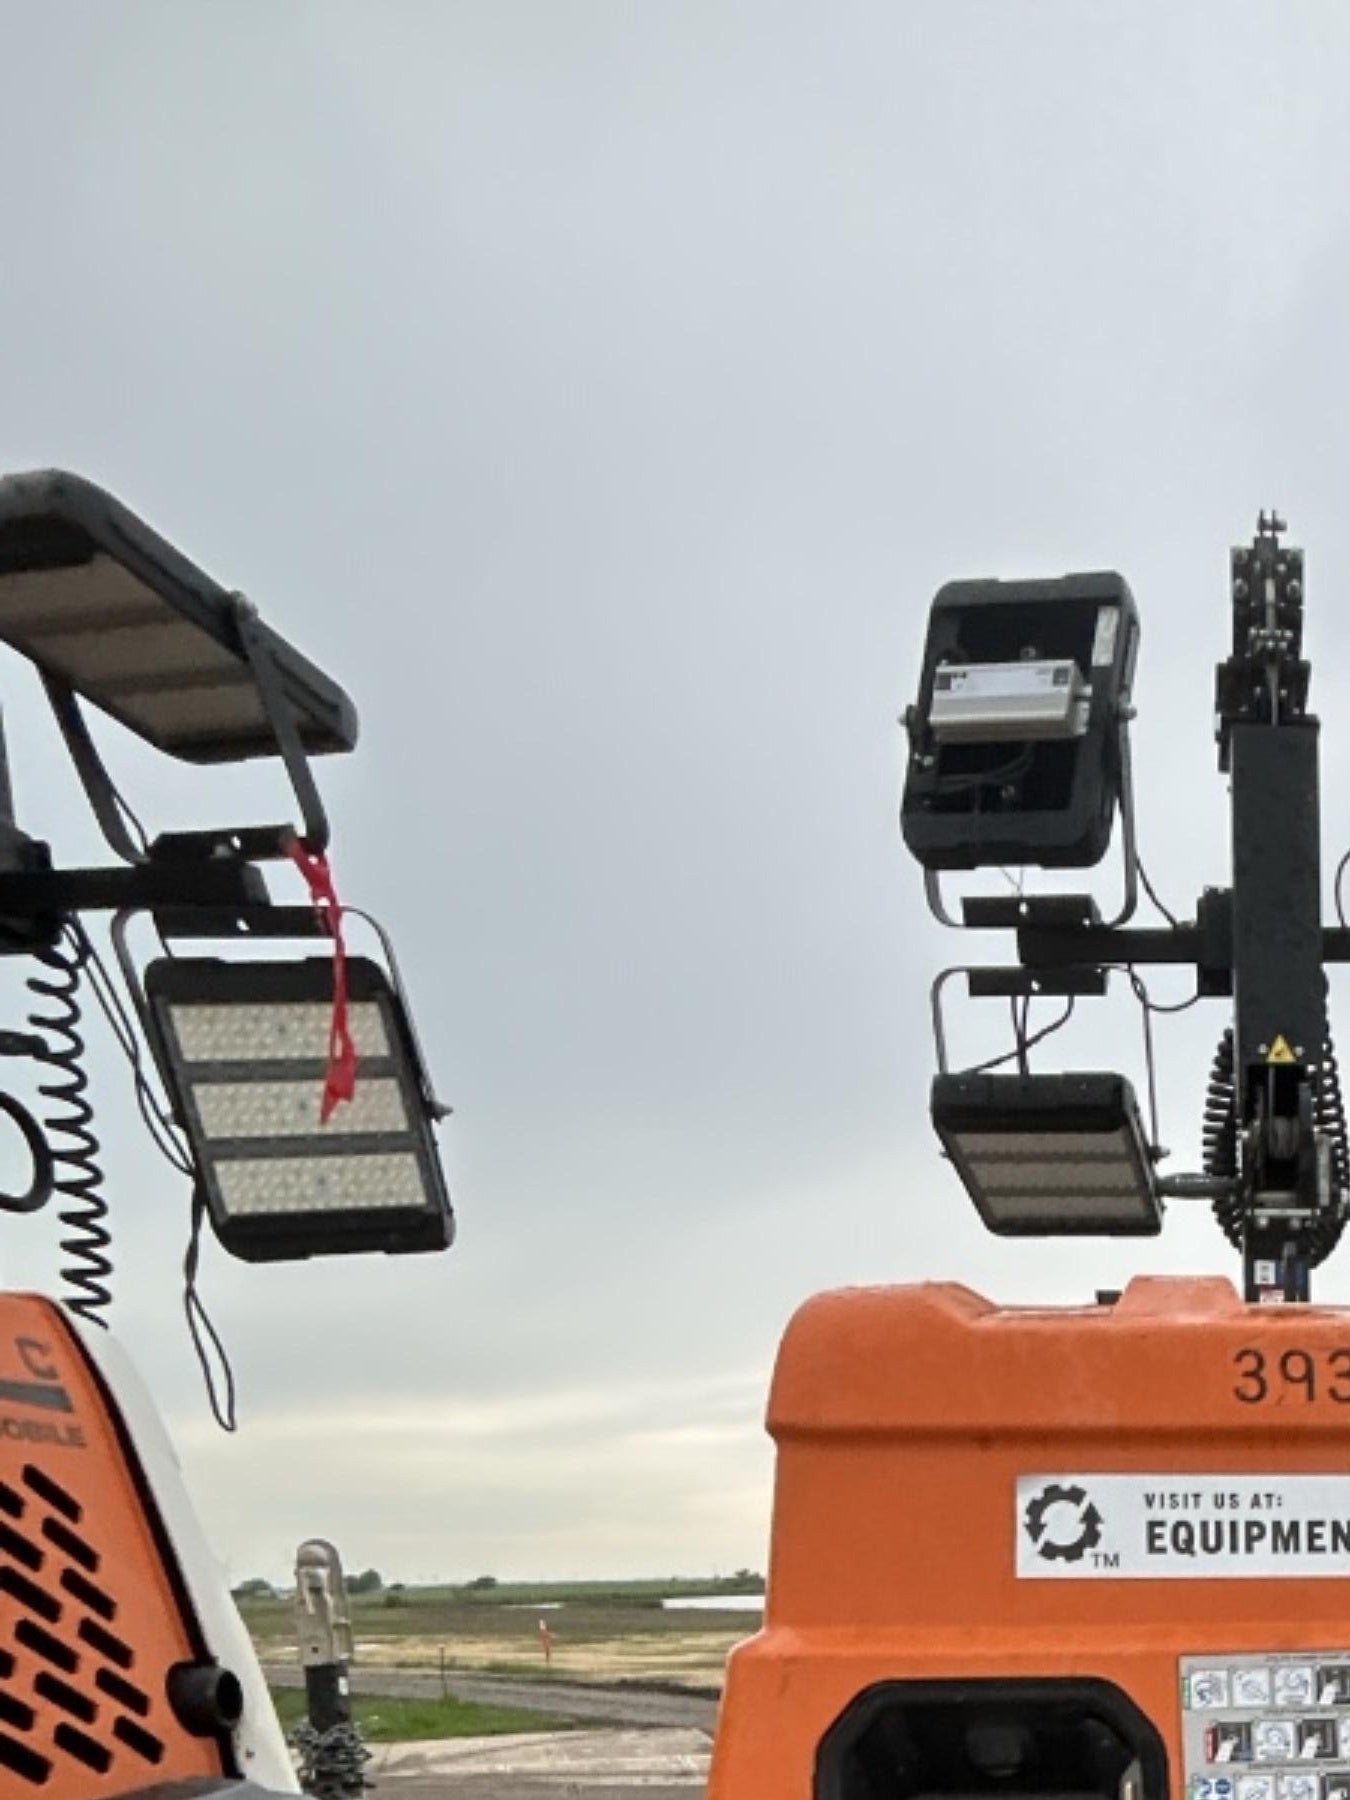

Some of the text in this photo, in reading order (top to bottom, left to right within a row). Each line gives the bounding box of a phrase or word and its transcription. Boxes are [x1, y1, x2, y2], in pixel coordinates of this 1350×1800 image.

[1144, 1492, 1285, 1510] VISIT US AT:
